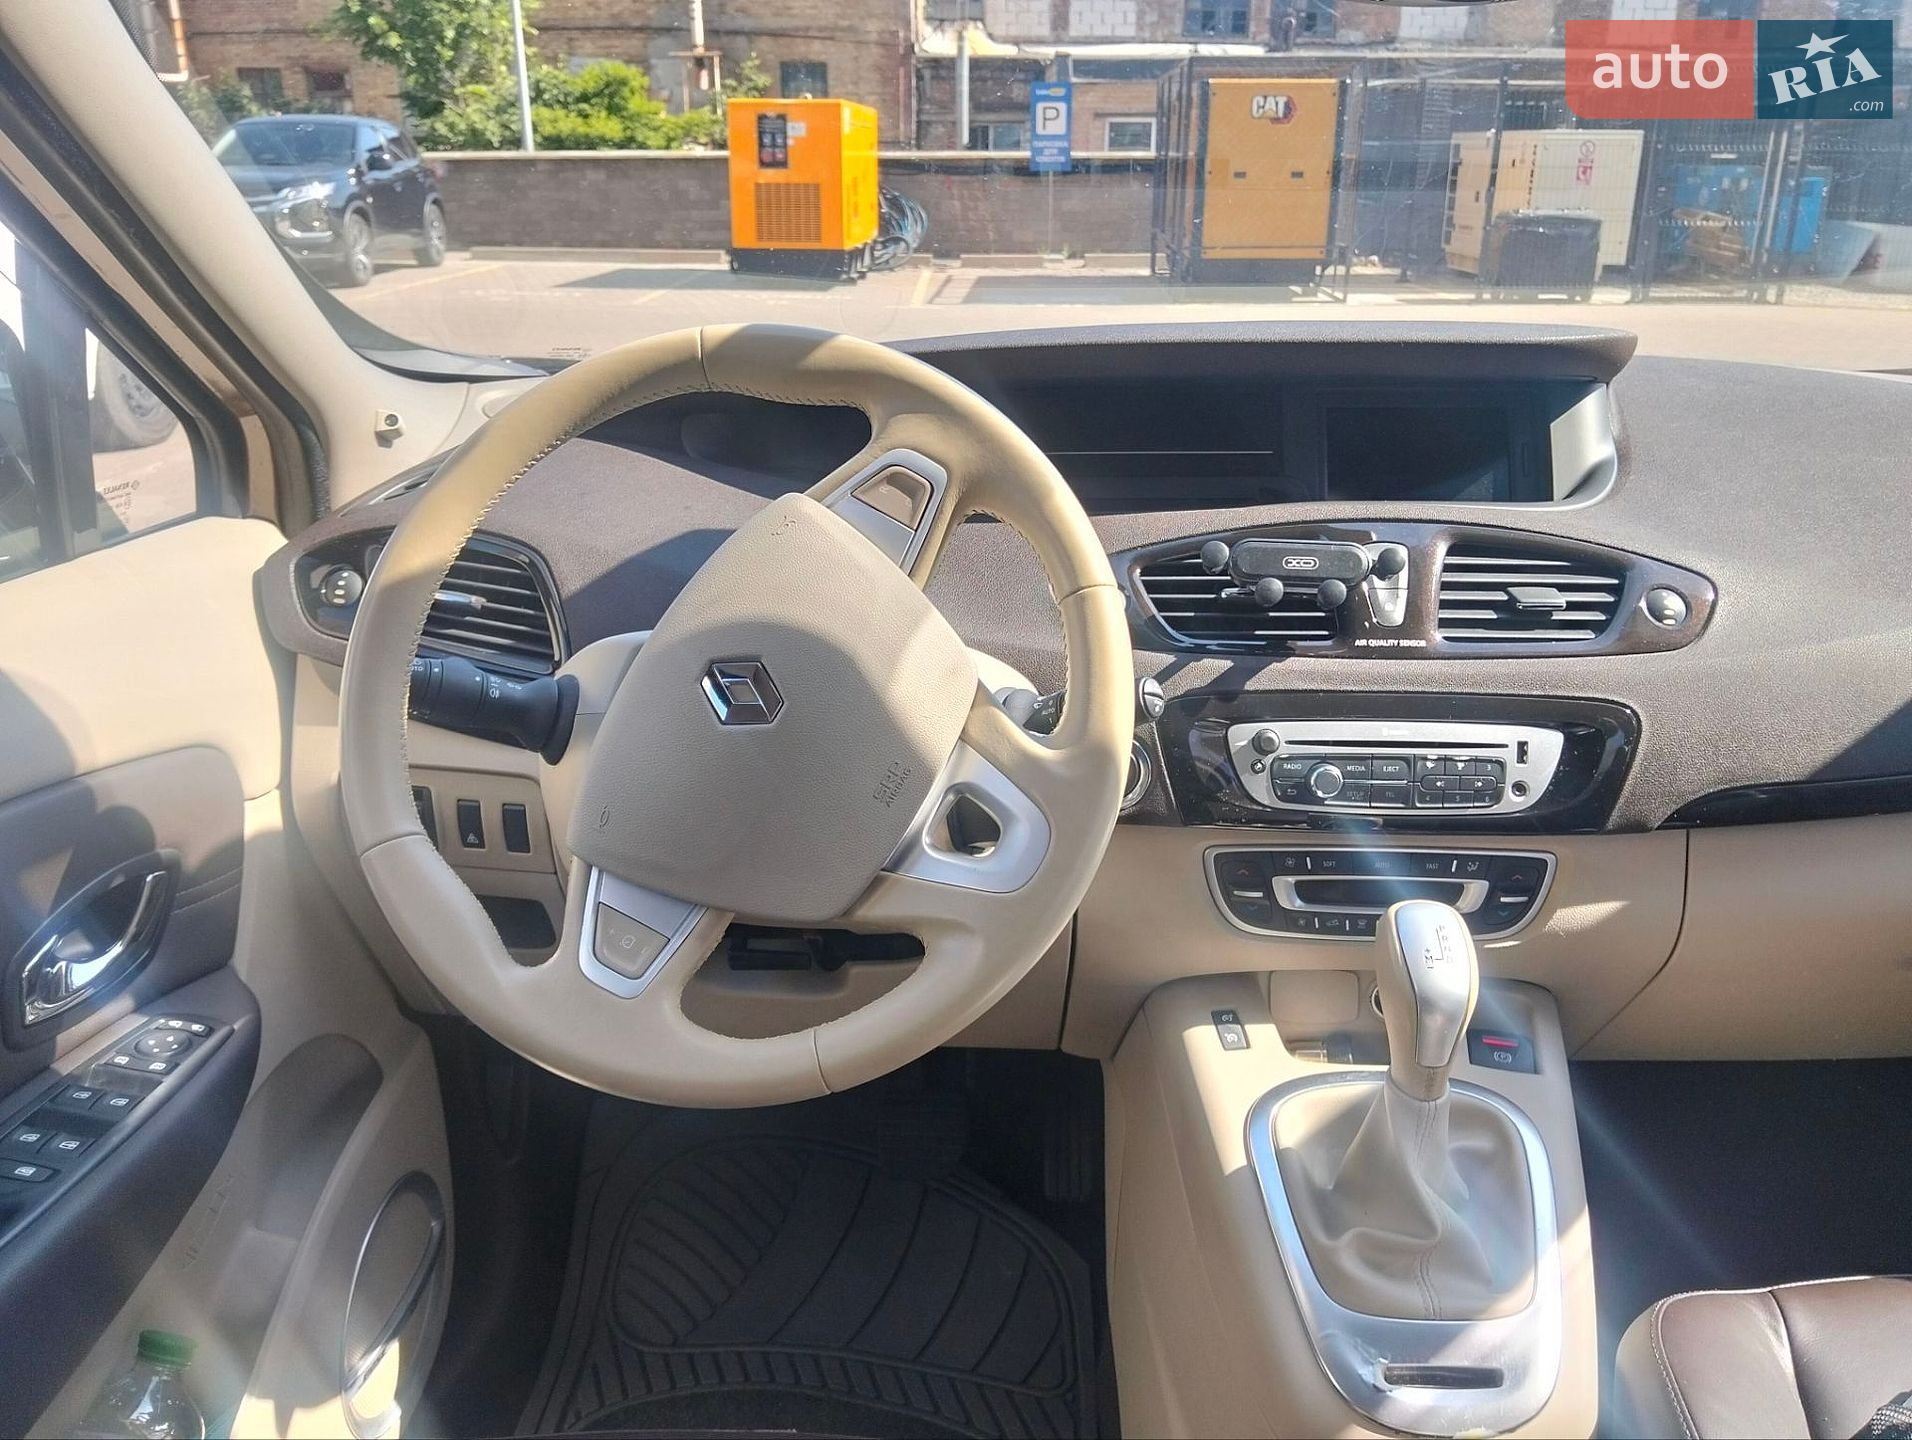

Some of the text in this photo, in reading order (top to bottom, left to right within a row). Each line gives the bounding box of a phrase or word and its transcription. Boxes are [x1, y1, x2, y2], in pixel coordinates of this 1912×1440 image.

[1251, 95, 1288, 118] CAT
[1042, 106, 1060, 131] P
[1354, 639, 1427, 647] AIR QUALITY SENSOR
[886, 768, 911, 808] AIRBAG
[1323, 860, 1336, 868] SOFT
